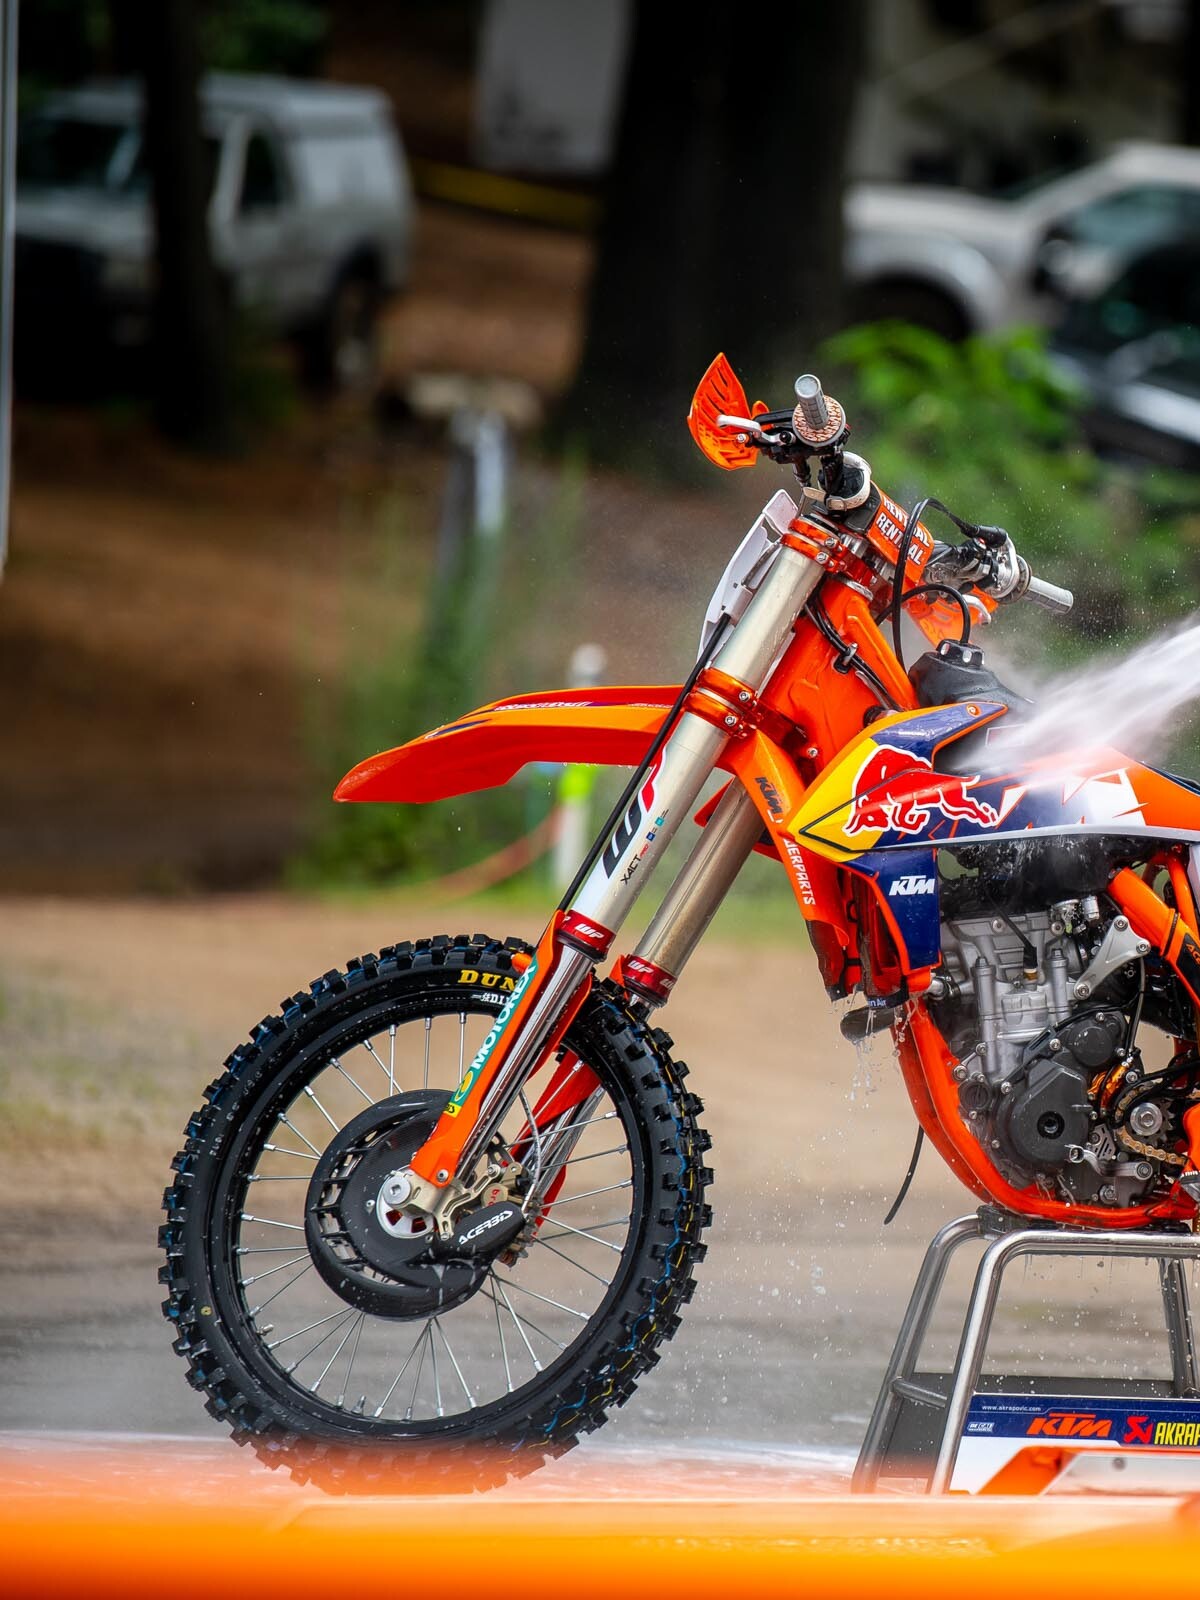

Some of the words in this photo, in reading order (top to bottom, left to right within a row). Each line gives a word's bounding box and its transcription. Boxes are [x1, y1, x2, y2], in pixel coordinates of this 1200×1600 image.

[883, 496, 930, 547] RENTAL
[876, 512, 924, 566] RENTAL
[754, 776, 784, 815] KTM
[620, 854, 643, 886] XACT
[889, 874, 936, 897] KTM
[574, 922, 605, 940] WP
[627, 960, 655, 974] WP
[470, 965, 537, 1070] MOTOREX
[458, 1210, 514, 1245] ACERBIS
[1026, 1412, 1113, 1437] KTM
